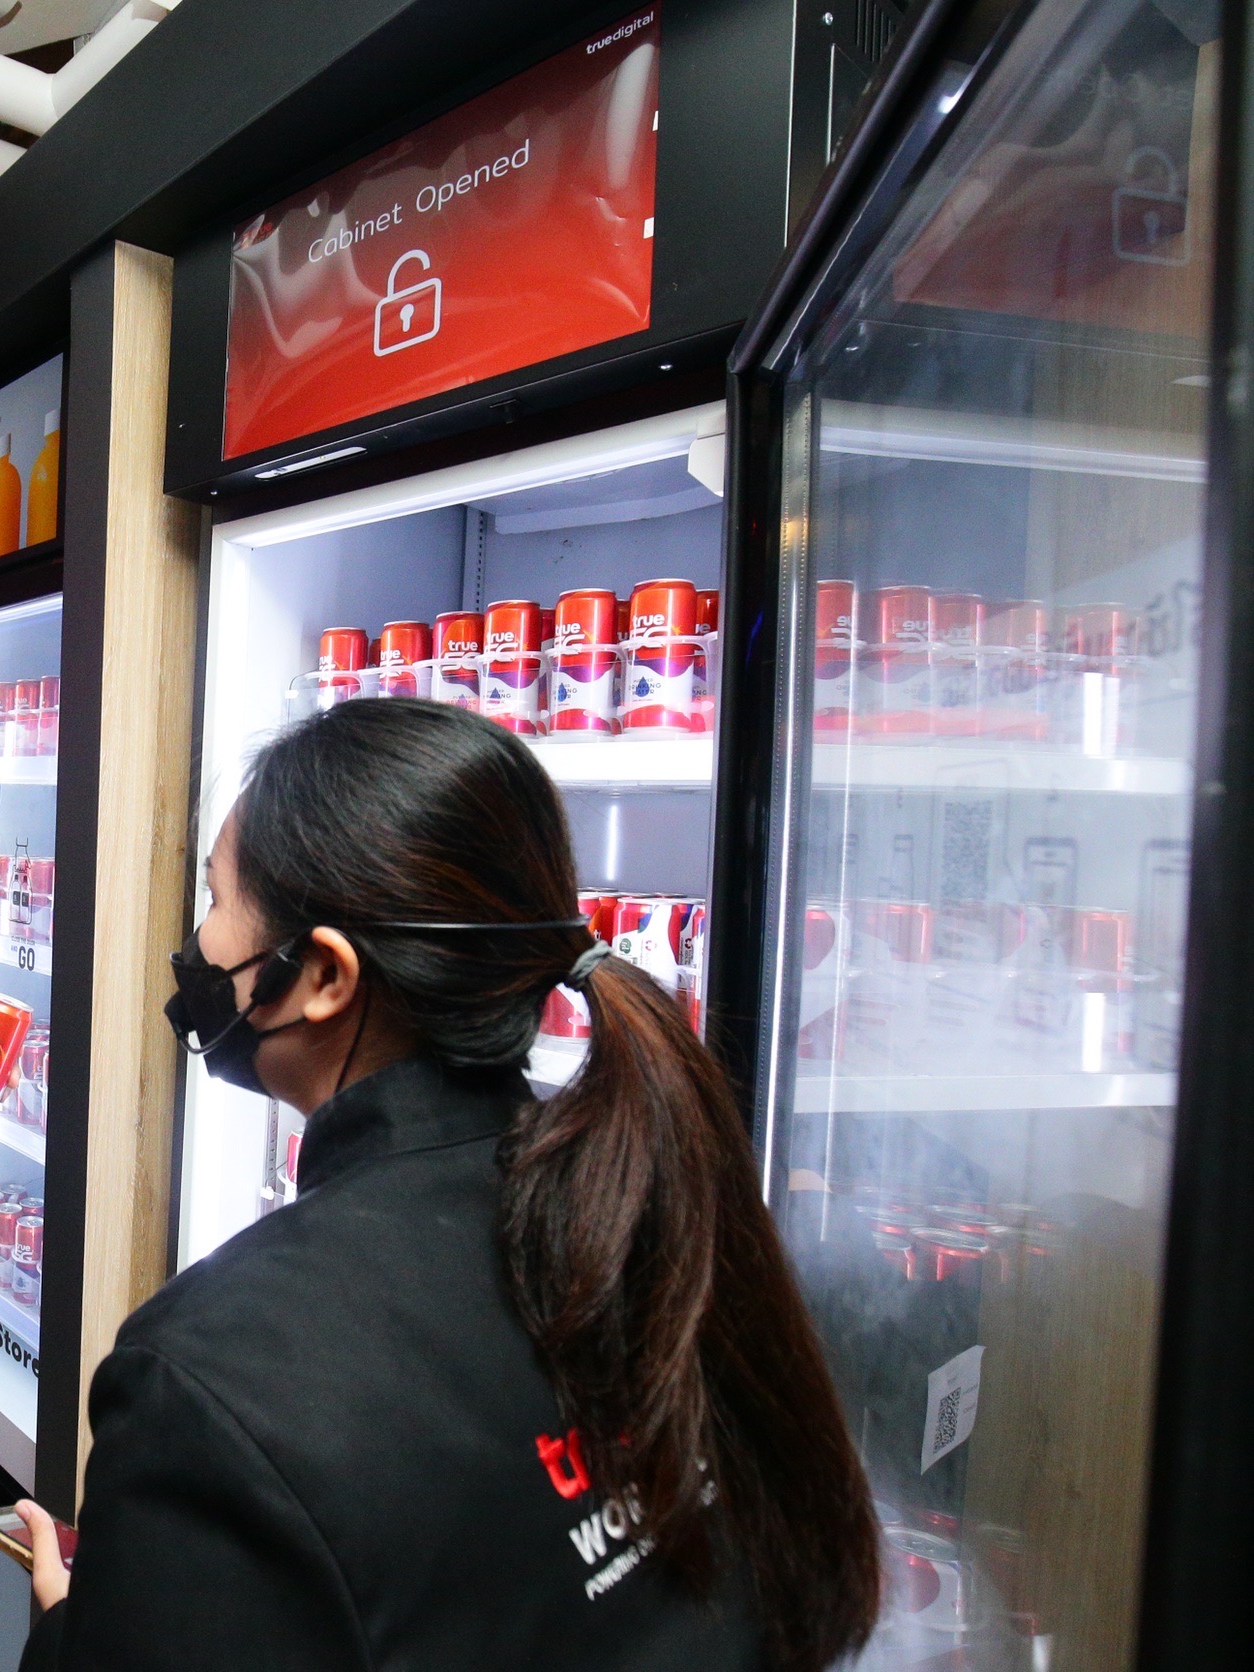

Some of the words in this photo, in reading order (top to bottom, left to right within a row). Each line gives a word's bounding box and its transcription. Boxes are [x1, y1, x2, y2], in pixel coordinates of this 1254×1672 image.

[586, 11, 655, 54] truedigital
[308, 202, 402, 263] Cabinet
[415, 138, 530, 214] Opened
[632, 614, 665, 627] true
[448, 640, 478, 651] true
[18, 945, 35, 971] GO
